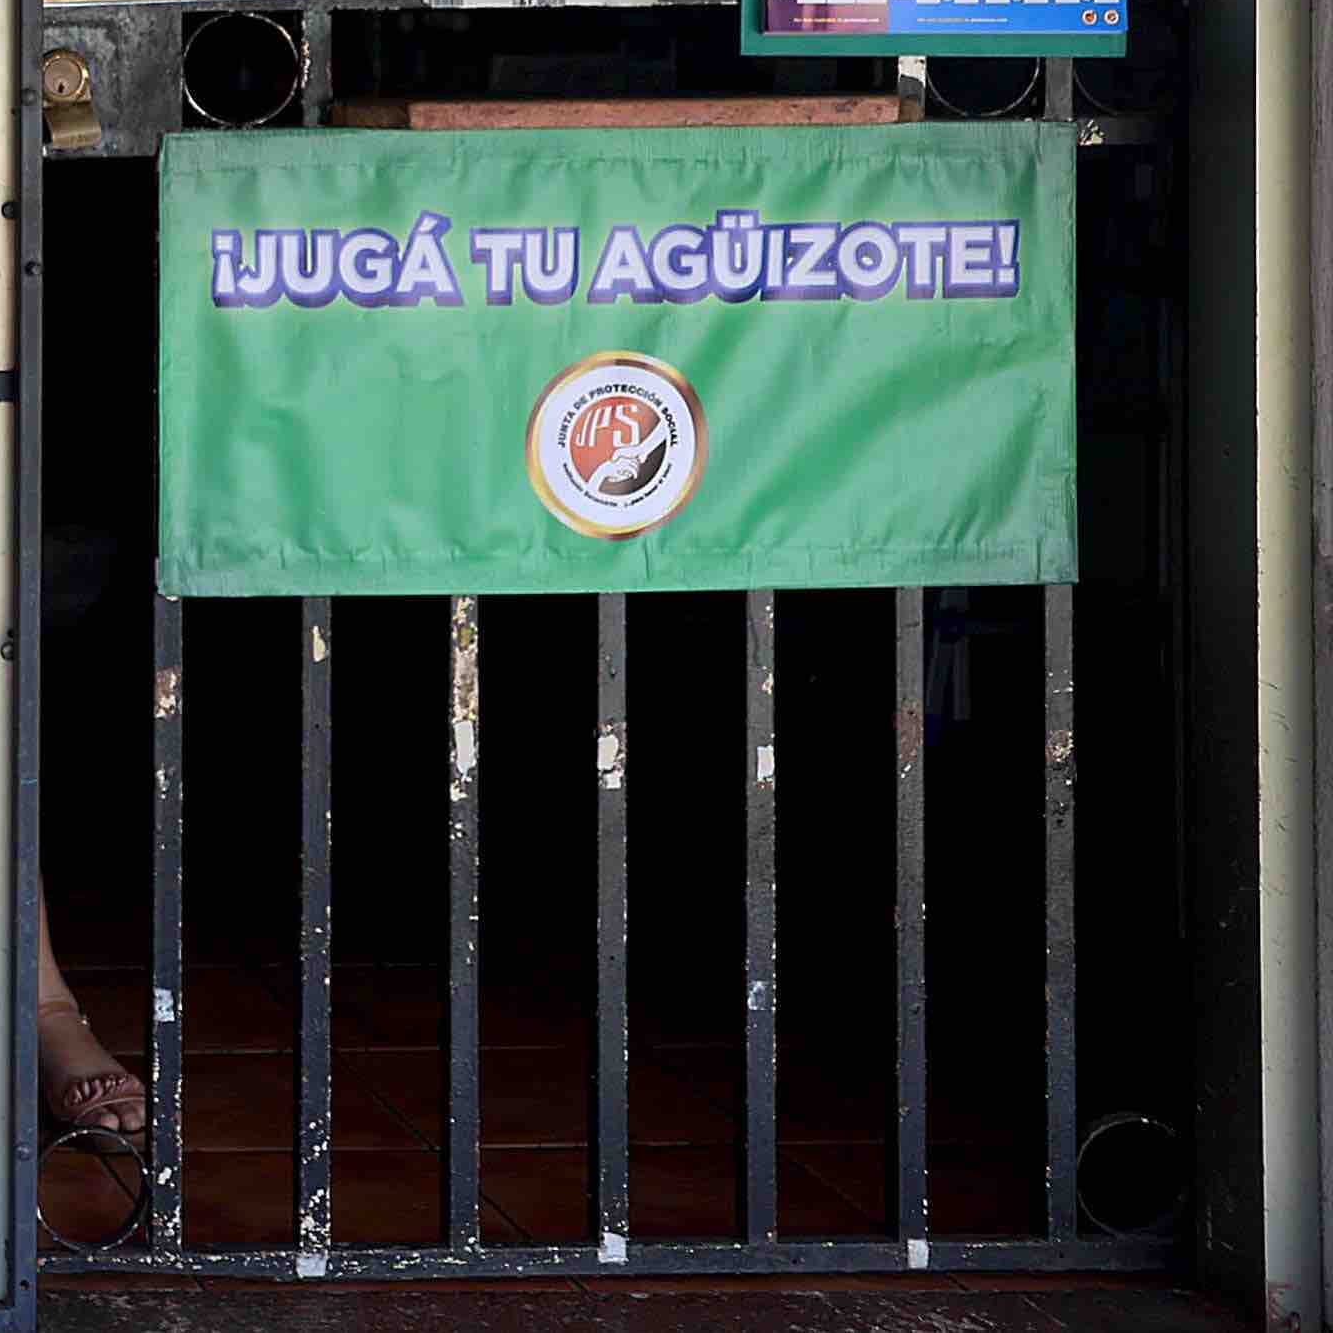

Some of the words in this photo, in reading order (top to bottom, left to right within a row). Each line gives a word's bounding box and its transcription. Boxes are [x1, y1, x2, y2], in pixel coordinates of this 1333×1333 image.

[210, 210, 464, 308] ¡JUGÁ
[470, 226, 580, 303] TU
[586, 210, 1021, 304] AGÜIZOTE!
[558, 410, 575, 448] JUNTA
[589, 384, 663, 408] PROTECCIÓN
[661, 407, 678, 447] SOCIAL
